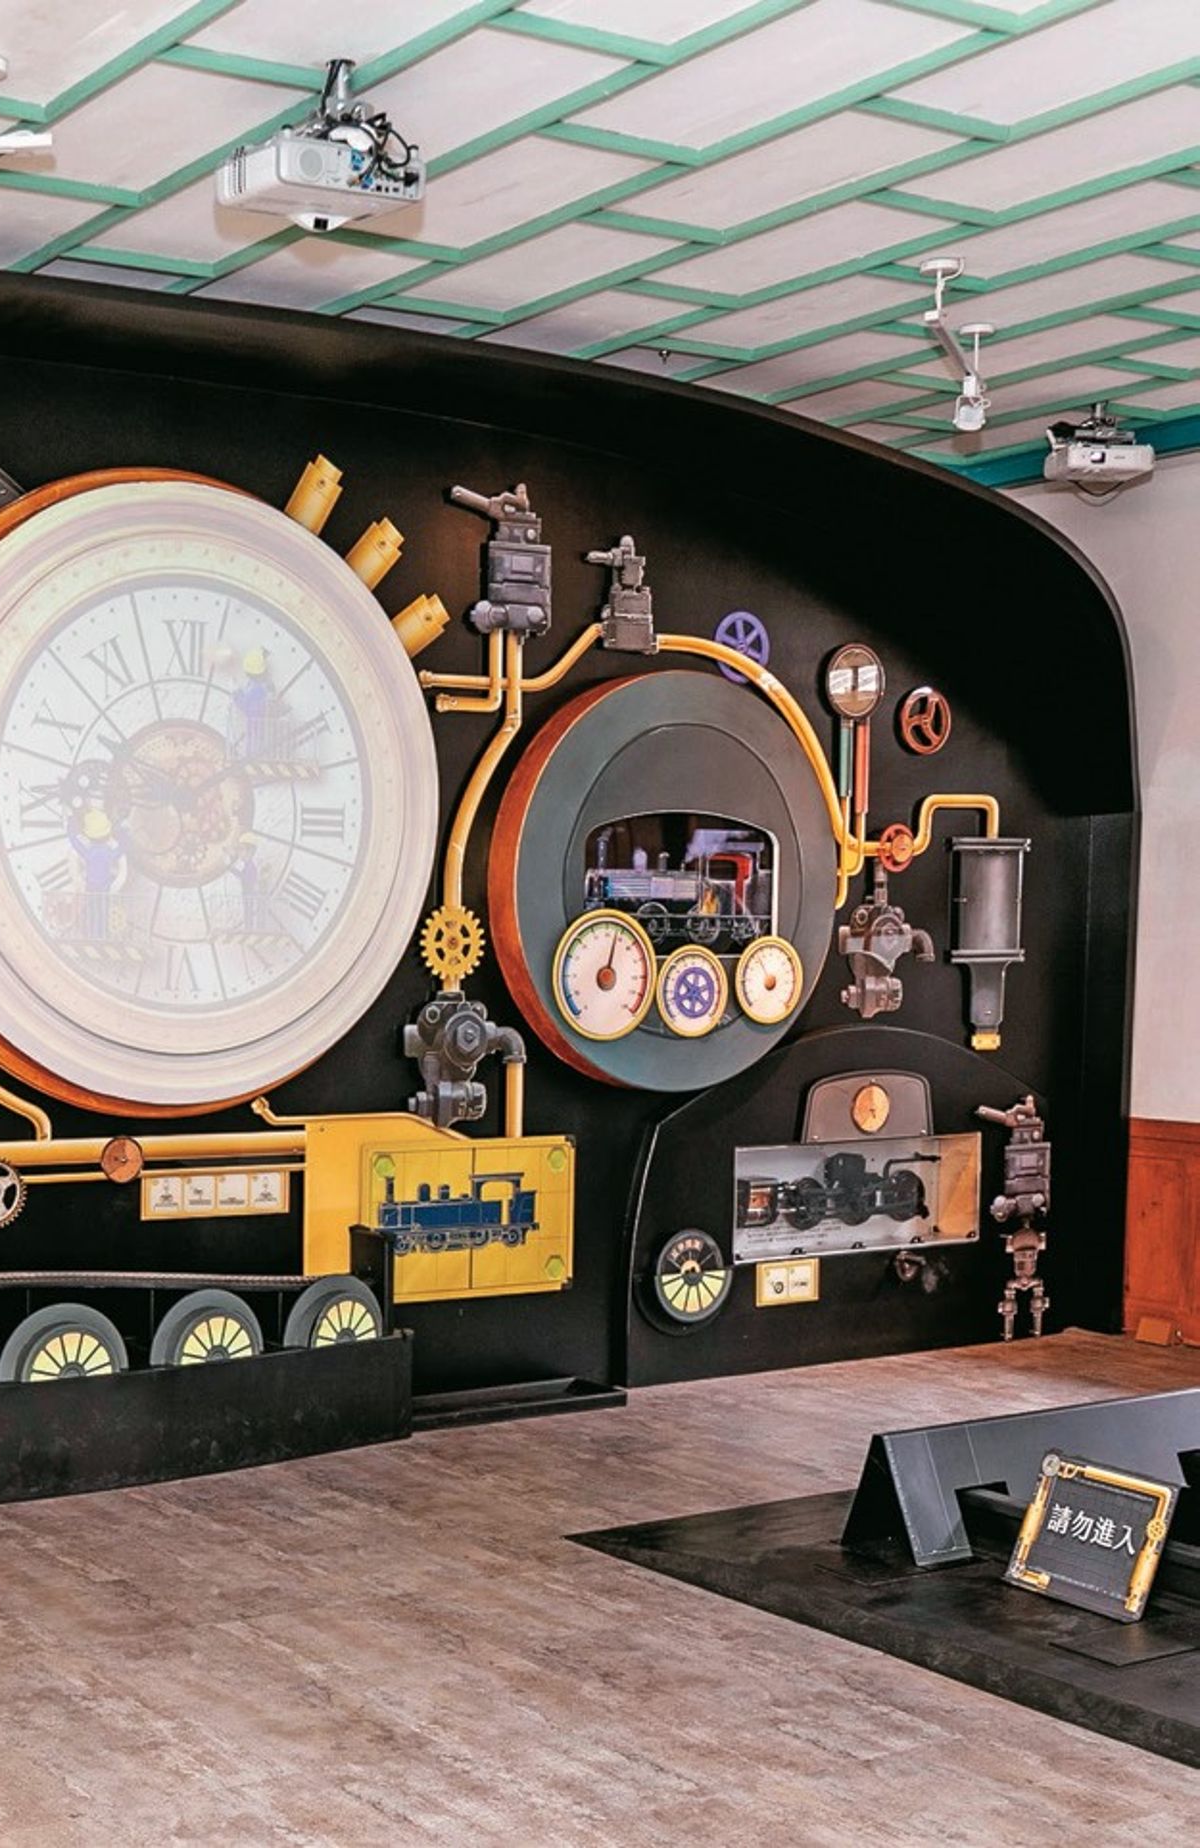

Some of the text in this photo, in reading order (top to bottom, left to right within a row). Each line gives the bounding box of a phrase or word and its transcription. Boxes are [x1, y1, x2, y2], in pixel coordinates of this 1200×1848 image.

[82, 635, 136, 699] XI
[162, 619, 209, 677] XII
[30, 699, 85, 753] X
[300, 801, 346, 844] III
[1046, 1502, 1136, 1556] 請勿進入
